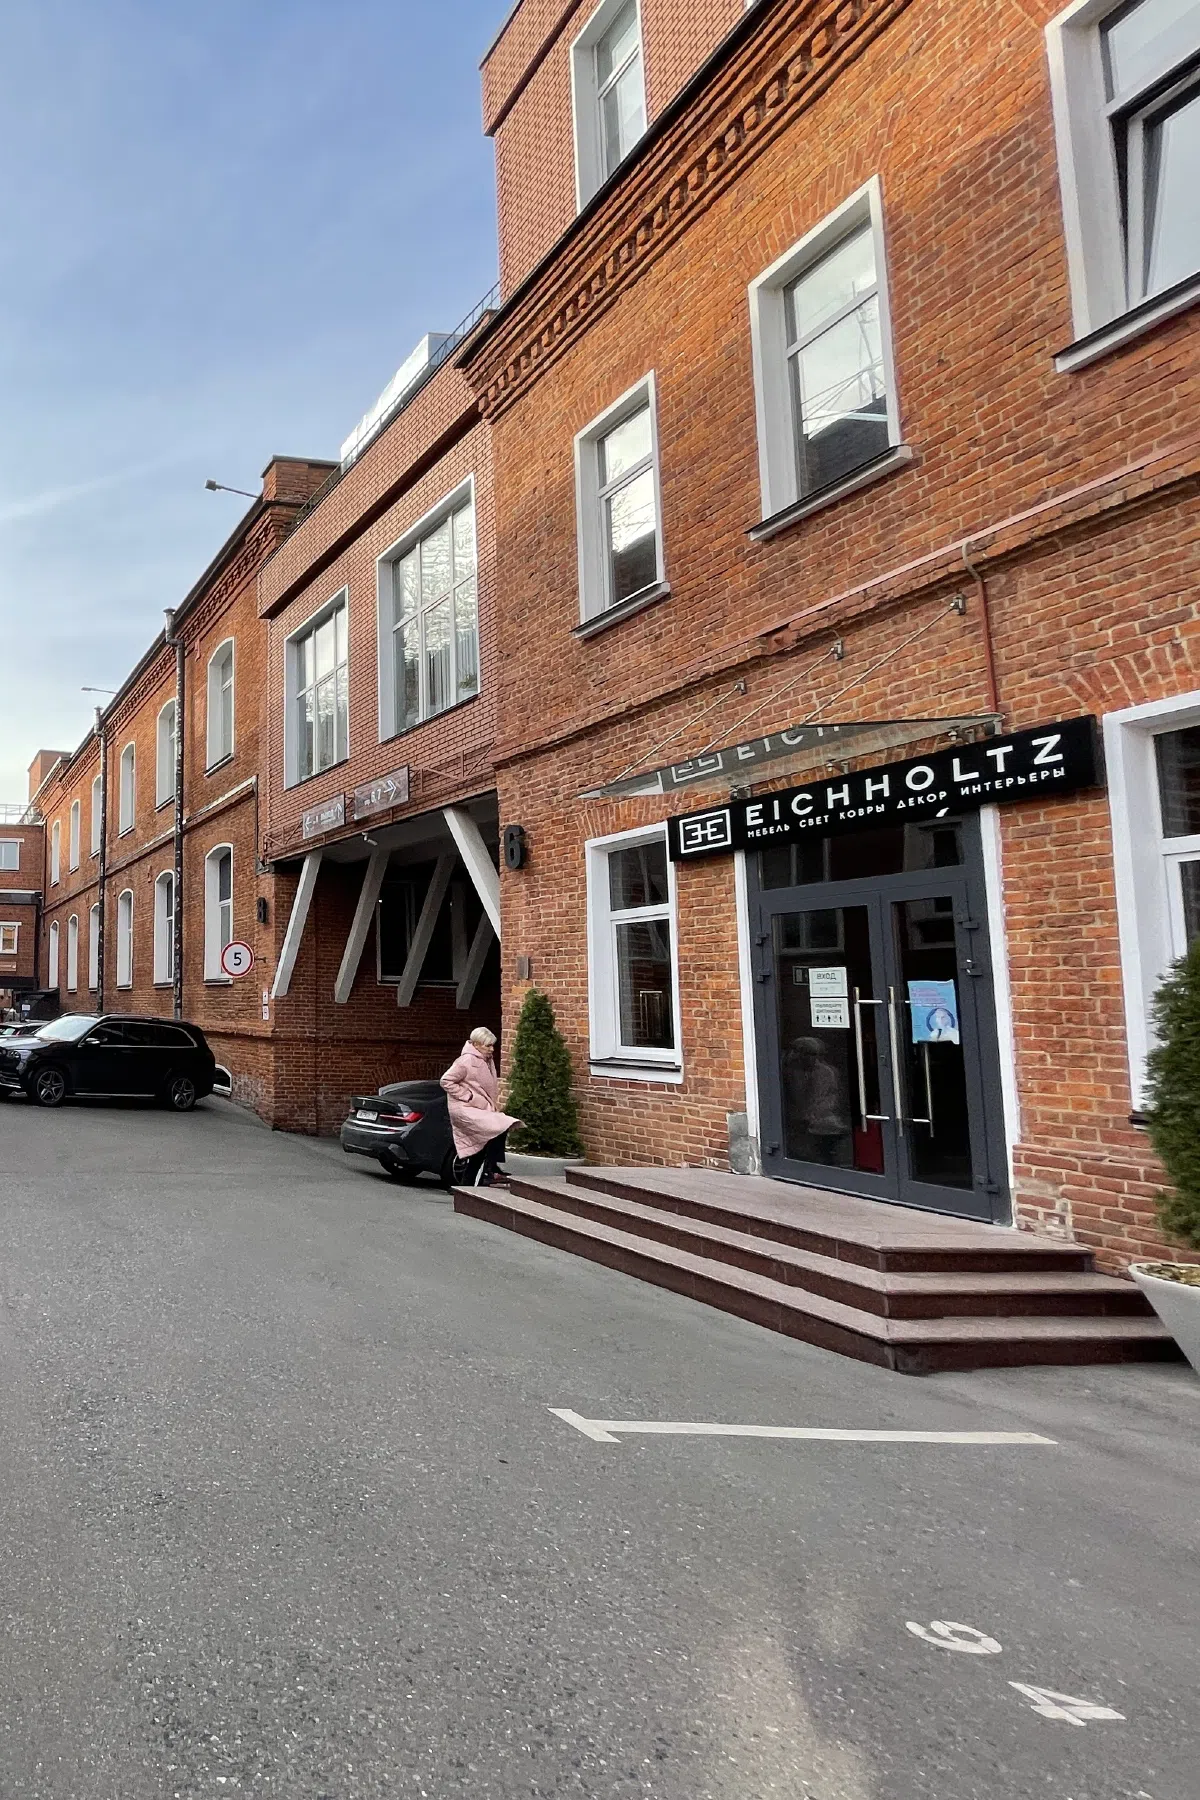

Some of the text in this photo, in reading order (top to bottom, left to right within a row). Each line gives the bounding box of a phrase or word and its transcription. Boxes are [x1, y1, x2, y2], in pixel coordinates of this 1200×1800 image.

[746, 734, 1064, 826] EICHHOLTZ
[747, 767, 1066, 838] МЕБЕЛЬ СВЕТ КОВРЫ ДЕКОР ИНТЕРЬЕРЫ
[504, 825, 526, 869] 6
[257, 896, 267, 923] 8
[233, 952, 242, 967] 5
[816, 972, 837, 981] ВХОД
